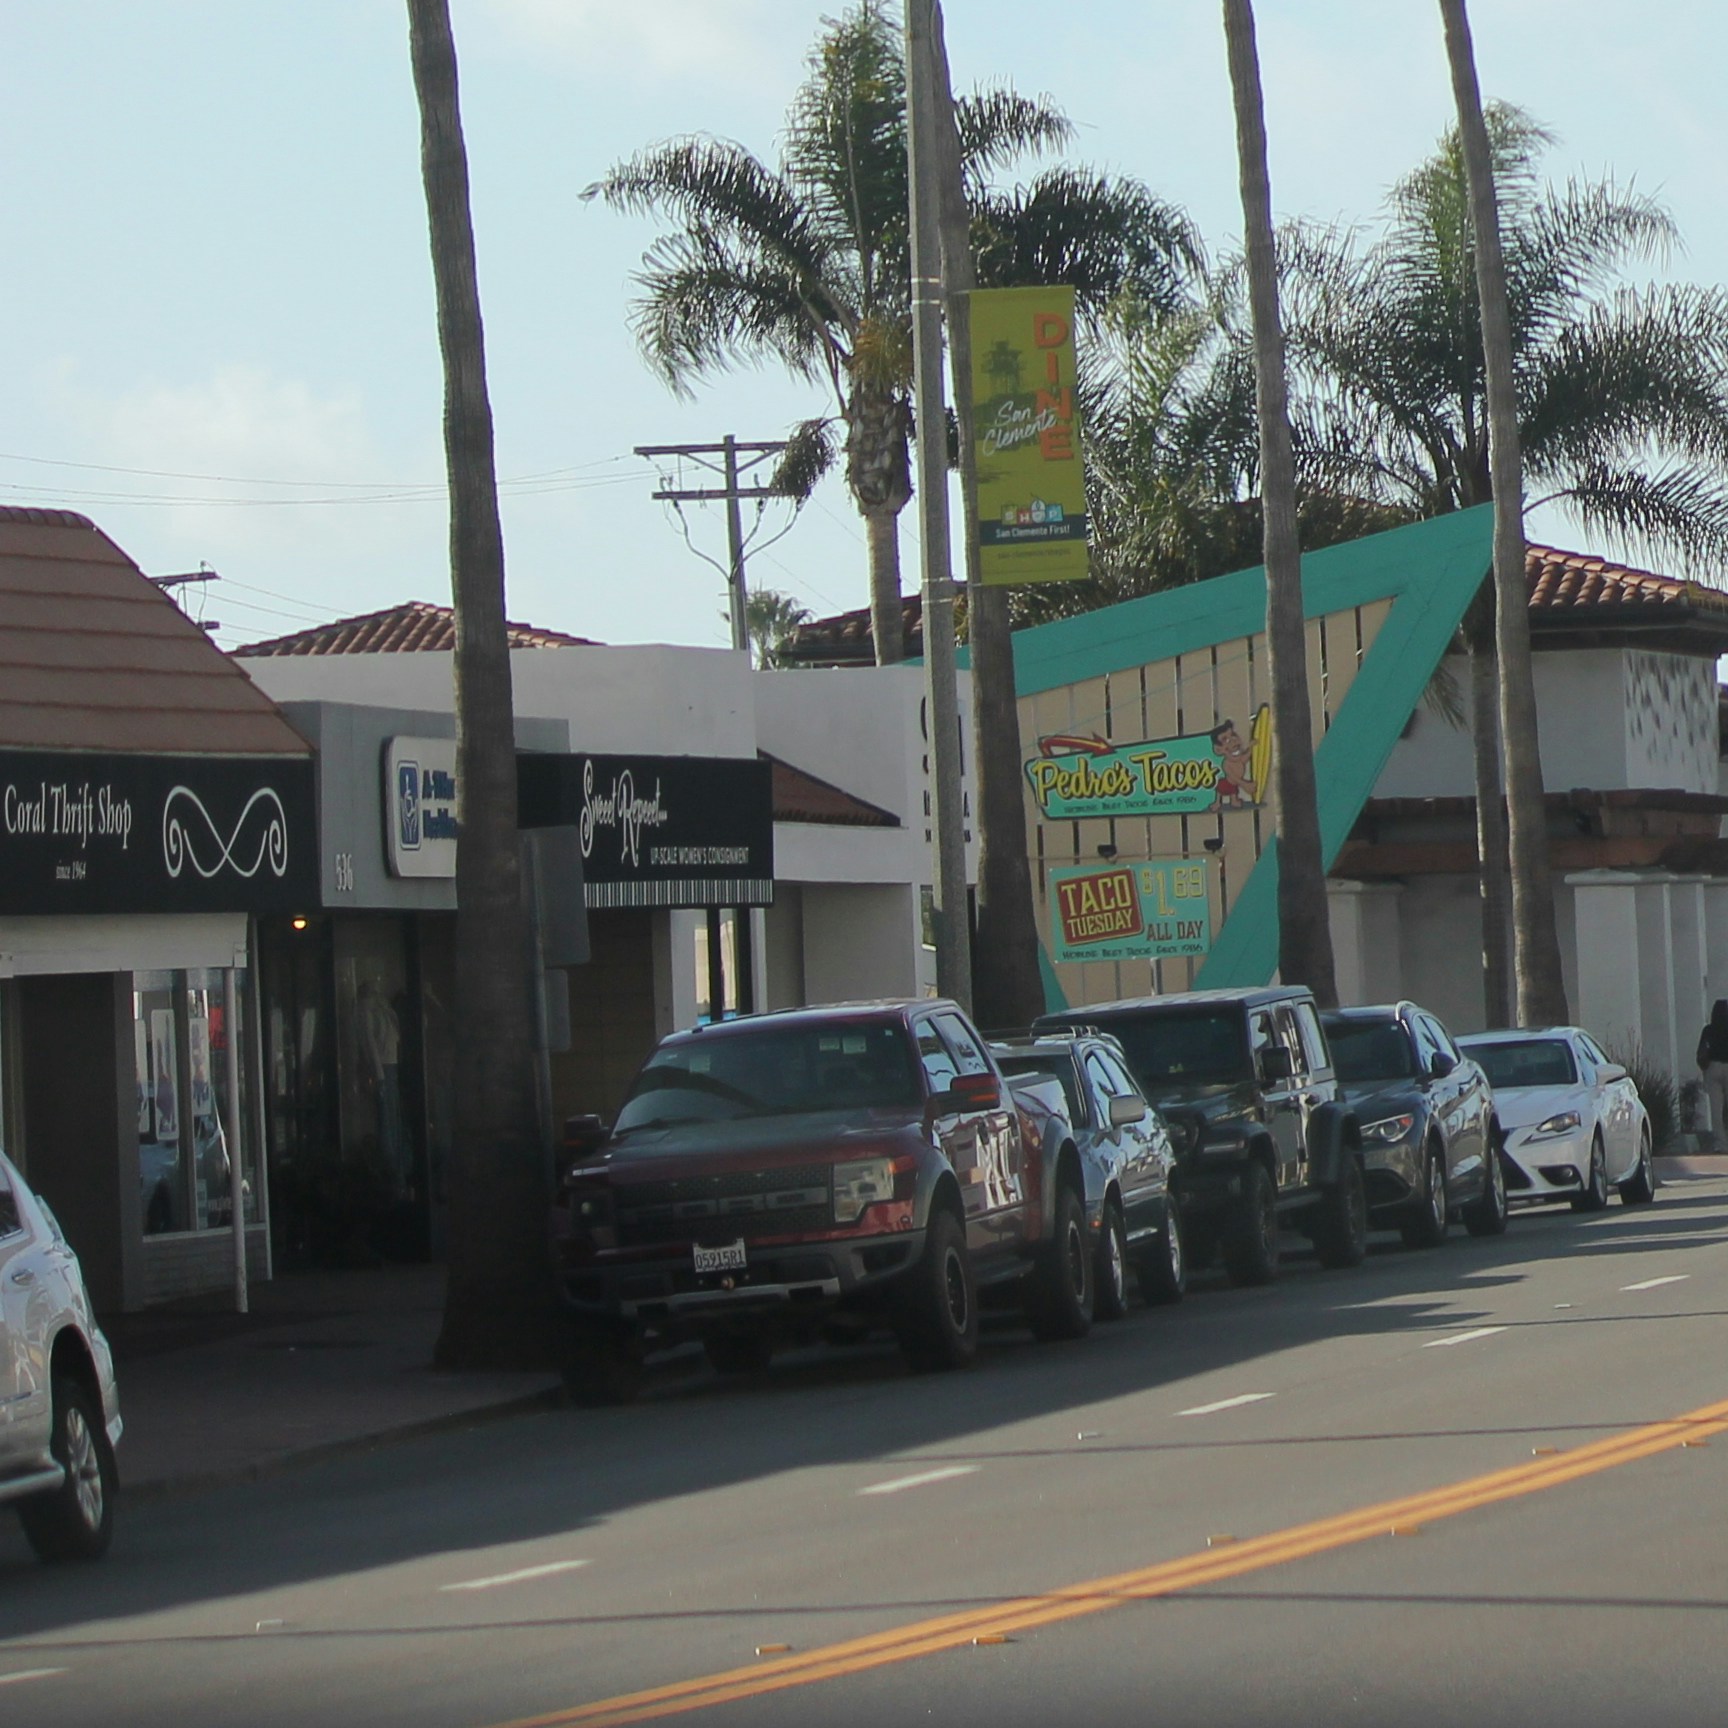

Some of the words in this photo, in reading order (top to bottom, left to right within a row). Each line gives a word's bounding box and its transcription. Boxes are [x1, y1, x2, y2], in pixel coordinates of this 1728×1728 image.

[1033, 312, 1075, 461] DINE
[995, 400, 1031, 426] San
[982, 406, 1058, 457] Clemente
[996, 528, 1011, 538] San
[1012, 526, 1047, 537] Clemente
[1049, 524, 1070, 535] First!
[1031, 757, 1137, 806] Pedro's
[1129, 752, 1220, 793] Tacos
[5, 782, 46, 833] Coral
[50, 782, 94, 849] Thrift
[98, 784, 132, 849] Shop
[72, 860, 86, 880] 1964
[650, 847, 678, 865] UP-SCALE
[679, 847, 707, 865] WOMEN'S
[708, 847, 750, 865] CONSIGNMENT
[335, 853, 353, 891] 536
[1061, 874, 1132, 918] TACO
[1066, 908, 1134, 939] TUESDAY
[1146, 923, 1173, 942] ALL
[1176, 920, 1204, 939] DAY
[695, 1249, 746, 1271] 05915R1
